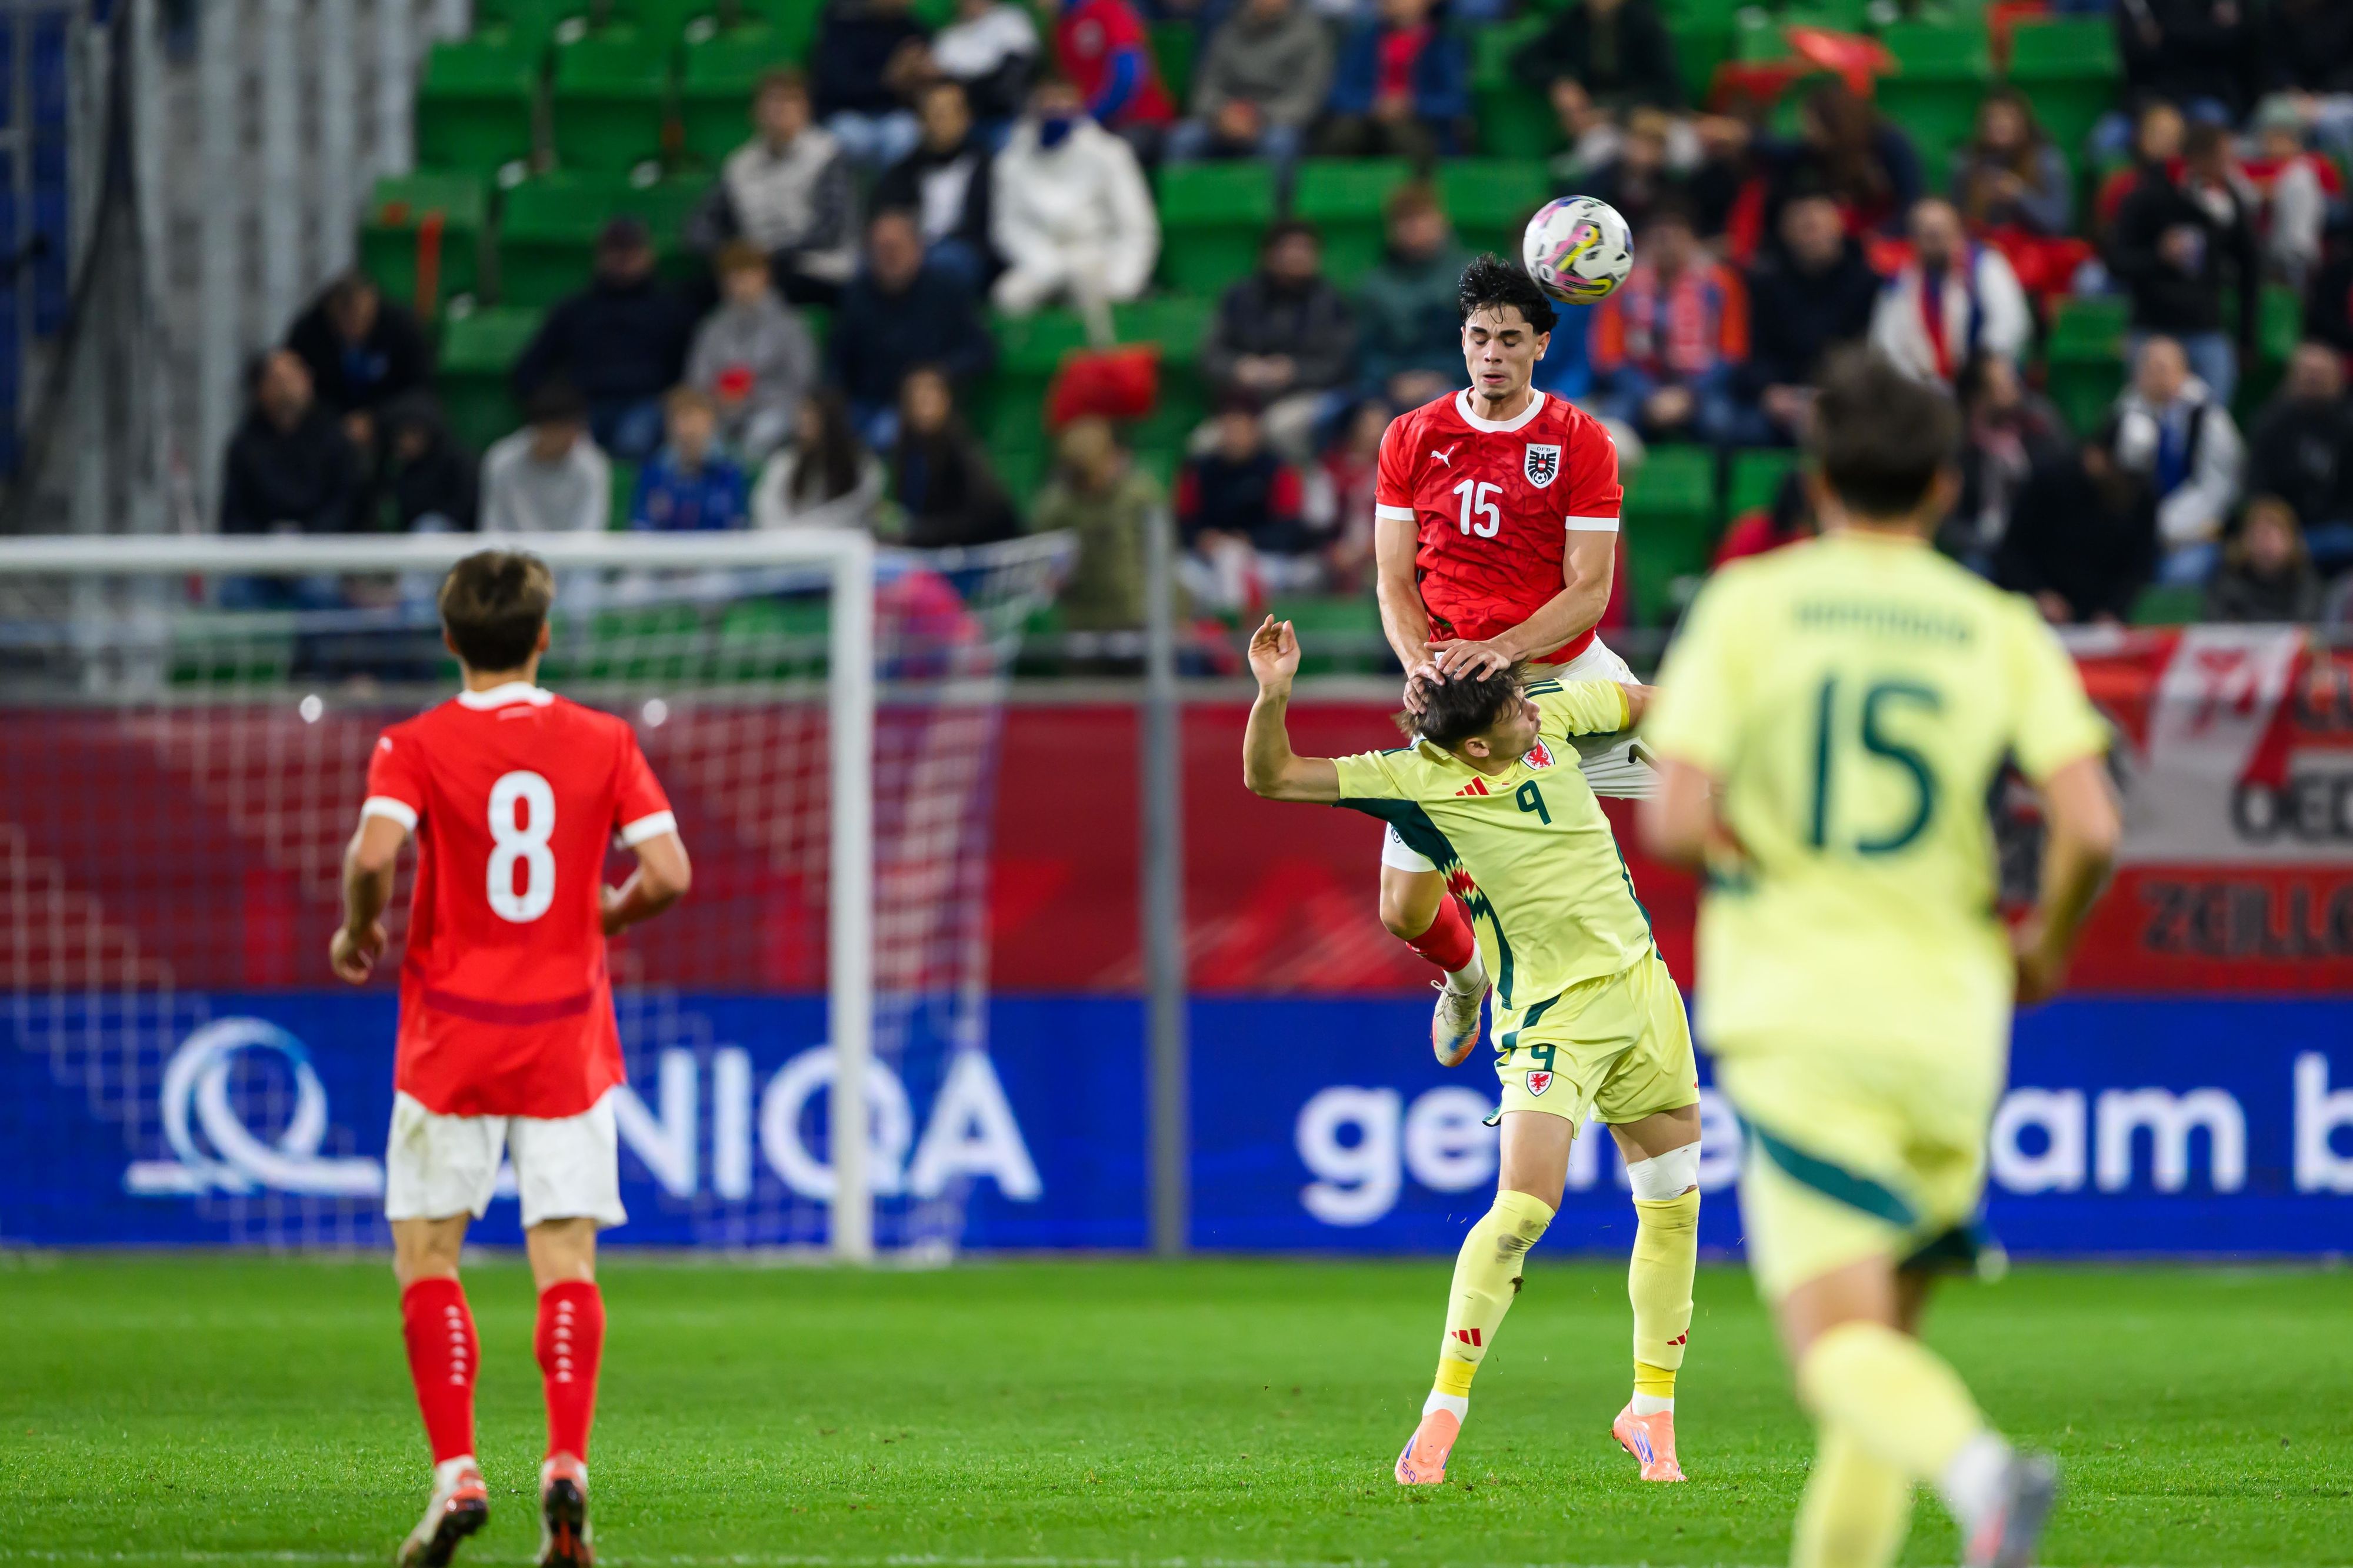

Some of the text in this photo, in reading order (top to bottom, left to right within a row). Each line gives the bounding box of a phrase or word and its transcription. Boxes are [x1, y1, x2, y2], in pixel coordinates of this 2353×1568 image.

[1453, 479, 1503, 538] 15
[1807, 669, 1944, 855] 15
[1516, 780, 1552, 825] 9
[486, 770, 556, 923] 8
[1531, 1043, 1557, 1070] 9
[612, 1045, 1046, 1201] NIQA
[1400, 1457, 1416, 1483] 50
